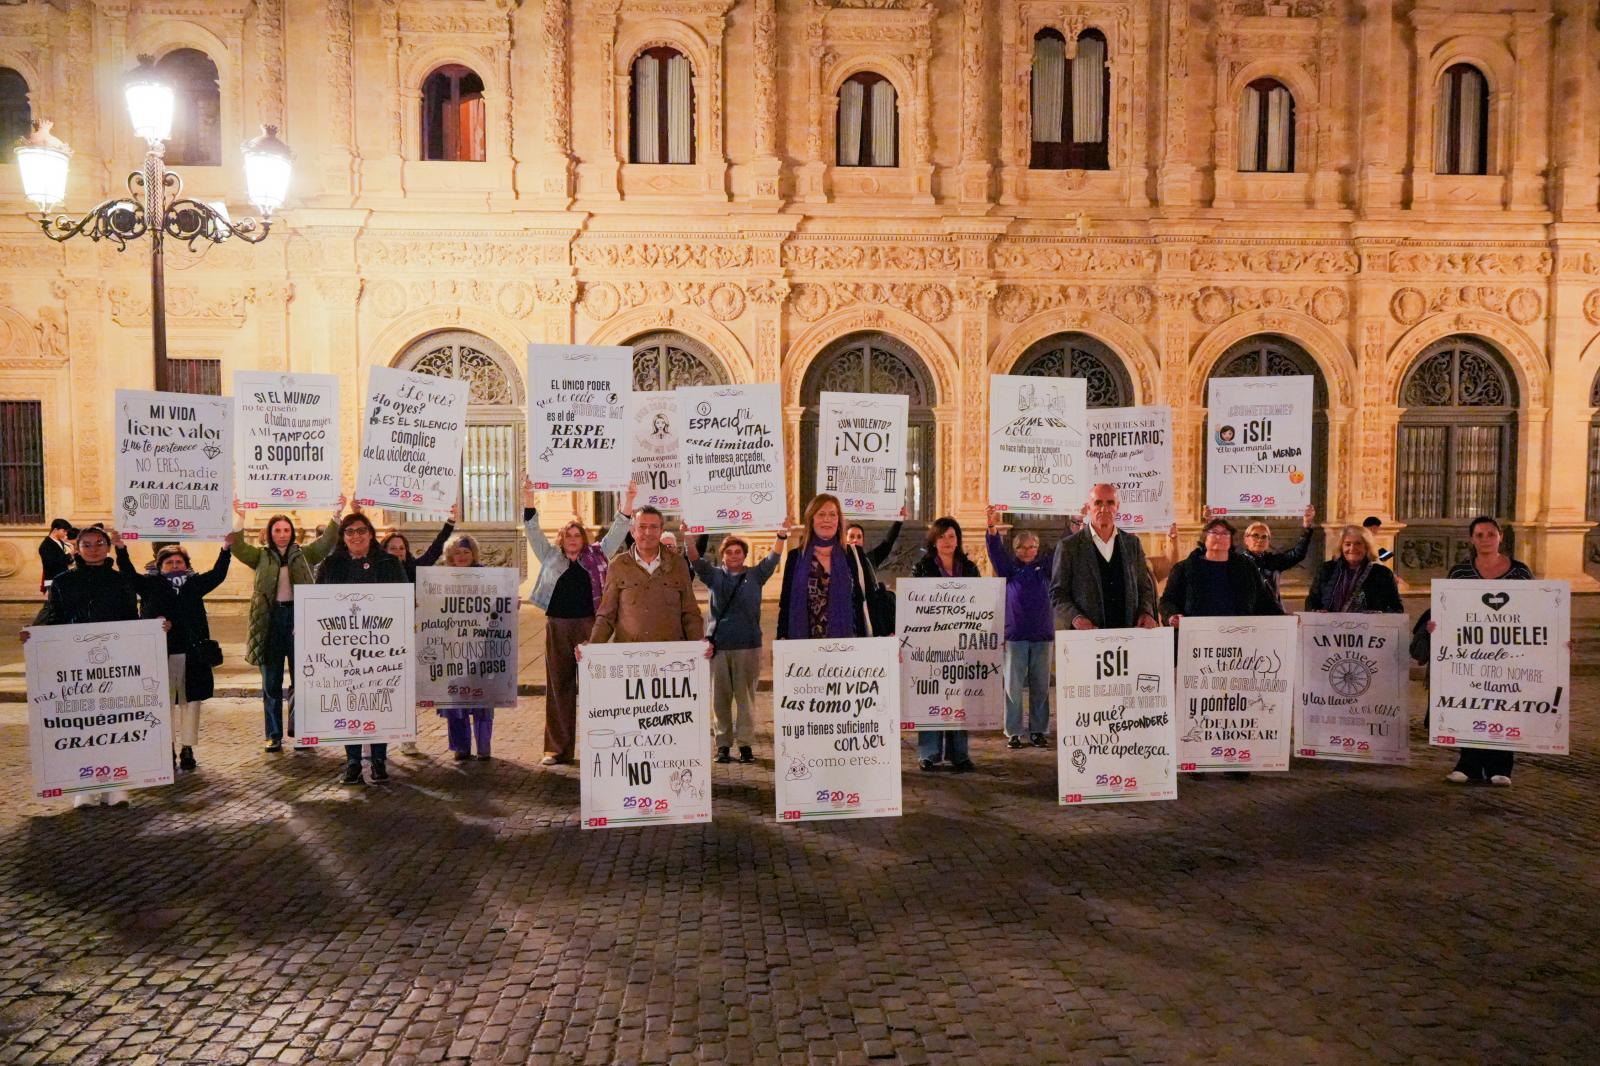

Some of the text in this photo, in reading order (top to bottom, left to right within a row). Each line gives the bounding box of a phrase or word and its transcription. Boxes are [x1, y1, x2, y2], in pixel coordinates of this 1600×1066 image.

[551, 380, 611, 391] EL PODER
[254, 391, 320, 405] SI EL MUNDO
[150, 405, 196, 421] MI VIDA
[392, 401, 425, 416] oyes?
[382, 415, 458, 431] ES EL SILENCIO
[550, 424, 605, 436] RESPE
[689, 417, 740, 430] ESPACIO
[736, 424, 771, 436] VITAL
[838, 418, 892, 430] ¿UN VIOLENTO?
[1101, 420, 1155, 431] QUIERES SER
[1243, 417, 1272, 444] ¡SÍ!
[272, 430, 325, 443] TAMPOCO
[391, 429, 436, 448] cómplice
[1005, 425, 1032, 437] sola
[1089, 429, 1164, 448] PROPIETARIO,
[121, 438, 198, 456] y pertenece
[551, 437, 616, 449] TARME!
[686, 437, 712, 448] está
[714, 437, 774, 450] limitado.
[835, 431, 890, 456] ¡NO!
[267, 441, 324, 466] soportar
[363, 445, 426, 462] de la violencia
[1258, 447, 1302, 461] LA MENDA
[136, 458, 180, 473] NO ERES
[179, 466, 218, 478] nadie
[403, 460, 456, 478] de género.
[838, 465, 886, 481] MALTRA
[1002, 465, 1051, 474] DE SOBRA
[1223, 462, 1297, 475] ENTIÉNDELO
[247, 473, 333, 481] MALTRATADOR.
[368, 473, 425, 490] ¡ACTÚA!
[649, 470, 668, 490] YO
[1029, 473, 1049, 484] LOS
[129, 480, 219, 491] PARA ACABAR
[139, 493, 211, 510] CON ELLA
[440, 596, 512, 614] JUEGOS DE
[916, 605, 967, 616] NUESTROS
[317, 615, 394, 630] TENGO EL MISMO
[966, 611, 994, 620] HIJOS
[1466, 613, 1520, 623] EL AMOR
[421, 617, 481, 632] plataforma.
[903, 621, 982, 633] para hacerme
[321, 631, 390, 646] derecho
[457, 628, 512, 639] LA PANTALLA
[958, 629, 998, 651] DAÑO
[1457, 625, 1548, 646] ¡NO DUELE!
[1313, 634, 1386, 649] LA VIDA ES
[350, 647, 386, 661] que
[1192, 647, 1243, 658] SI TE GUSTA
[1470, 648, 1524, 661] duele...
[324, 658, 354, 669] SOLA
[343, 669, 360, 677] POR
[376, 662, 403, 673] CALLE
[785, 662, 887, 678] Las decisiones
[1096, 646, 1129, 680] ¡SÍ!
[1320, 650, 1378, 675] una rueda
[57, 665, 141, 683] SI TE MOLESTAN
[430, 659, 476, 682] ya me la
[609, 665, 639, 678] SE TE
[1451, 662, 1544, 684] TIENE OTRO NOMBRE
[625, 677, 697, 700] LA OLLA,
[793, 680, 879, 696] sobre MI VIDA
[1483, 681, 1522, 693] llama
[55, 699, 96, 713] REDES
[320, 694, 341, 712] LA
[1201, 693, 1247, 716] póntelo
[1310, 692, 1326, 705] las
[1437, 686, 1563, 714] MALTRATO!
[588, 702, 670, 719] siempre puedes
[781, 695, 876, 718] las tomo yo.
[43, 710, 145, 730] bloquéame
[638, 710, 694, 730] RECURRIR
[1093, 705, 1125, 727] qué?
[1109, 712, 1169, 734] RESPONDERÉ
[1205, 718, 1259, 729] DEJA DE
[794, 719, 879, 739] ya tienes suficiente
[1204, 729, 1278, 741] BABOSEAR!
[1366, 720, 1390, 736] TÚ
[54, 729, 148, 751] GRACIAS!
[613, 733, 677, 747] AL CAZO.
[834, 734, 886, 752] con ser
[1063, 733, 1120, 746] CUANDO
[1088, 744, 1170, 759] me apetezca.
[808, 755, 891, 768] como eres...
[628, 759, 703, 786] NO ACERQUES.
